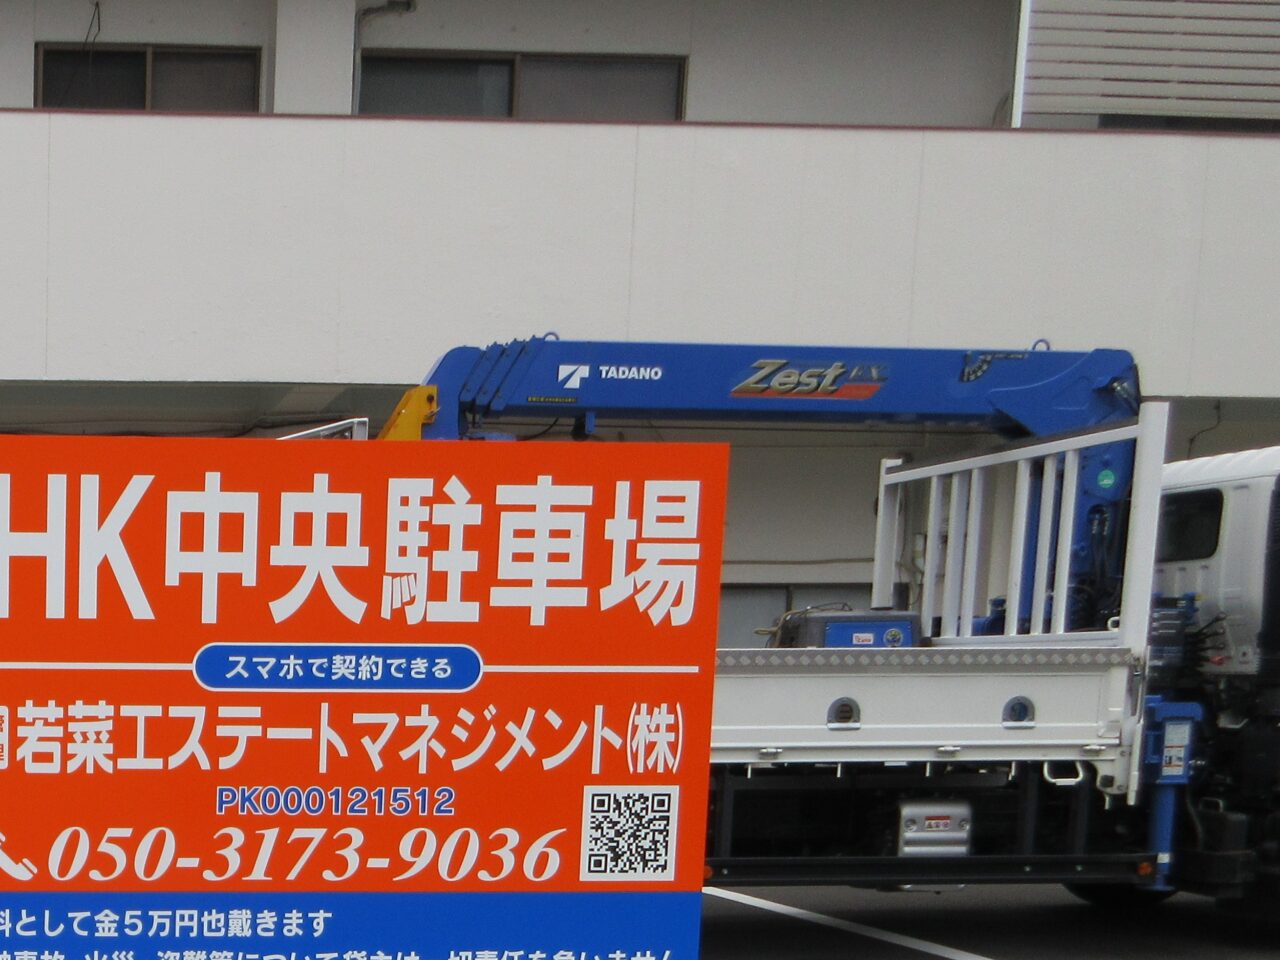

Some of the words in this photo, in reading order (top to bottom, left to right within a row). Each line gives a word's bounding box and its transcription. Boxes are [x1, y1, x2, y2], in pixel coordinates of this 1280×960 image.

[599, 365, 662, 380] TADANO
[731, 359, 846, 393] Zest
[225, 654, 453, 681] スマホで契約できる
[16, 699, 683, 775] 若菜エステートマネジメント(株)
[216, 786, 456, 816] PK000121512
[48, 826, 568, 882] 050-3173-9036
